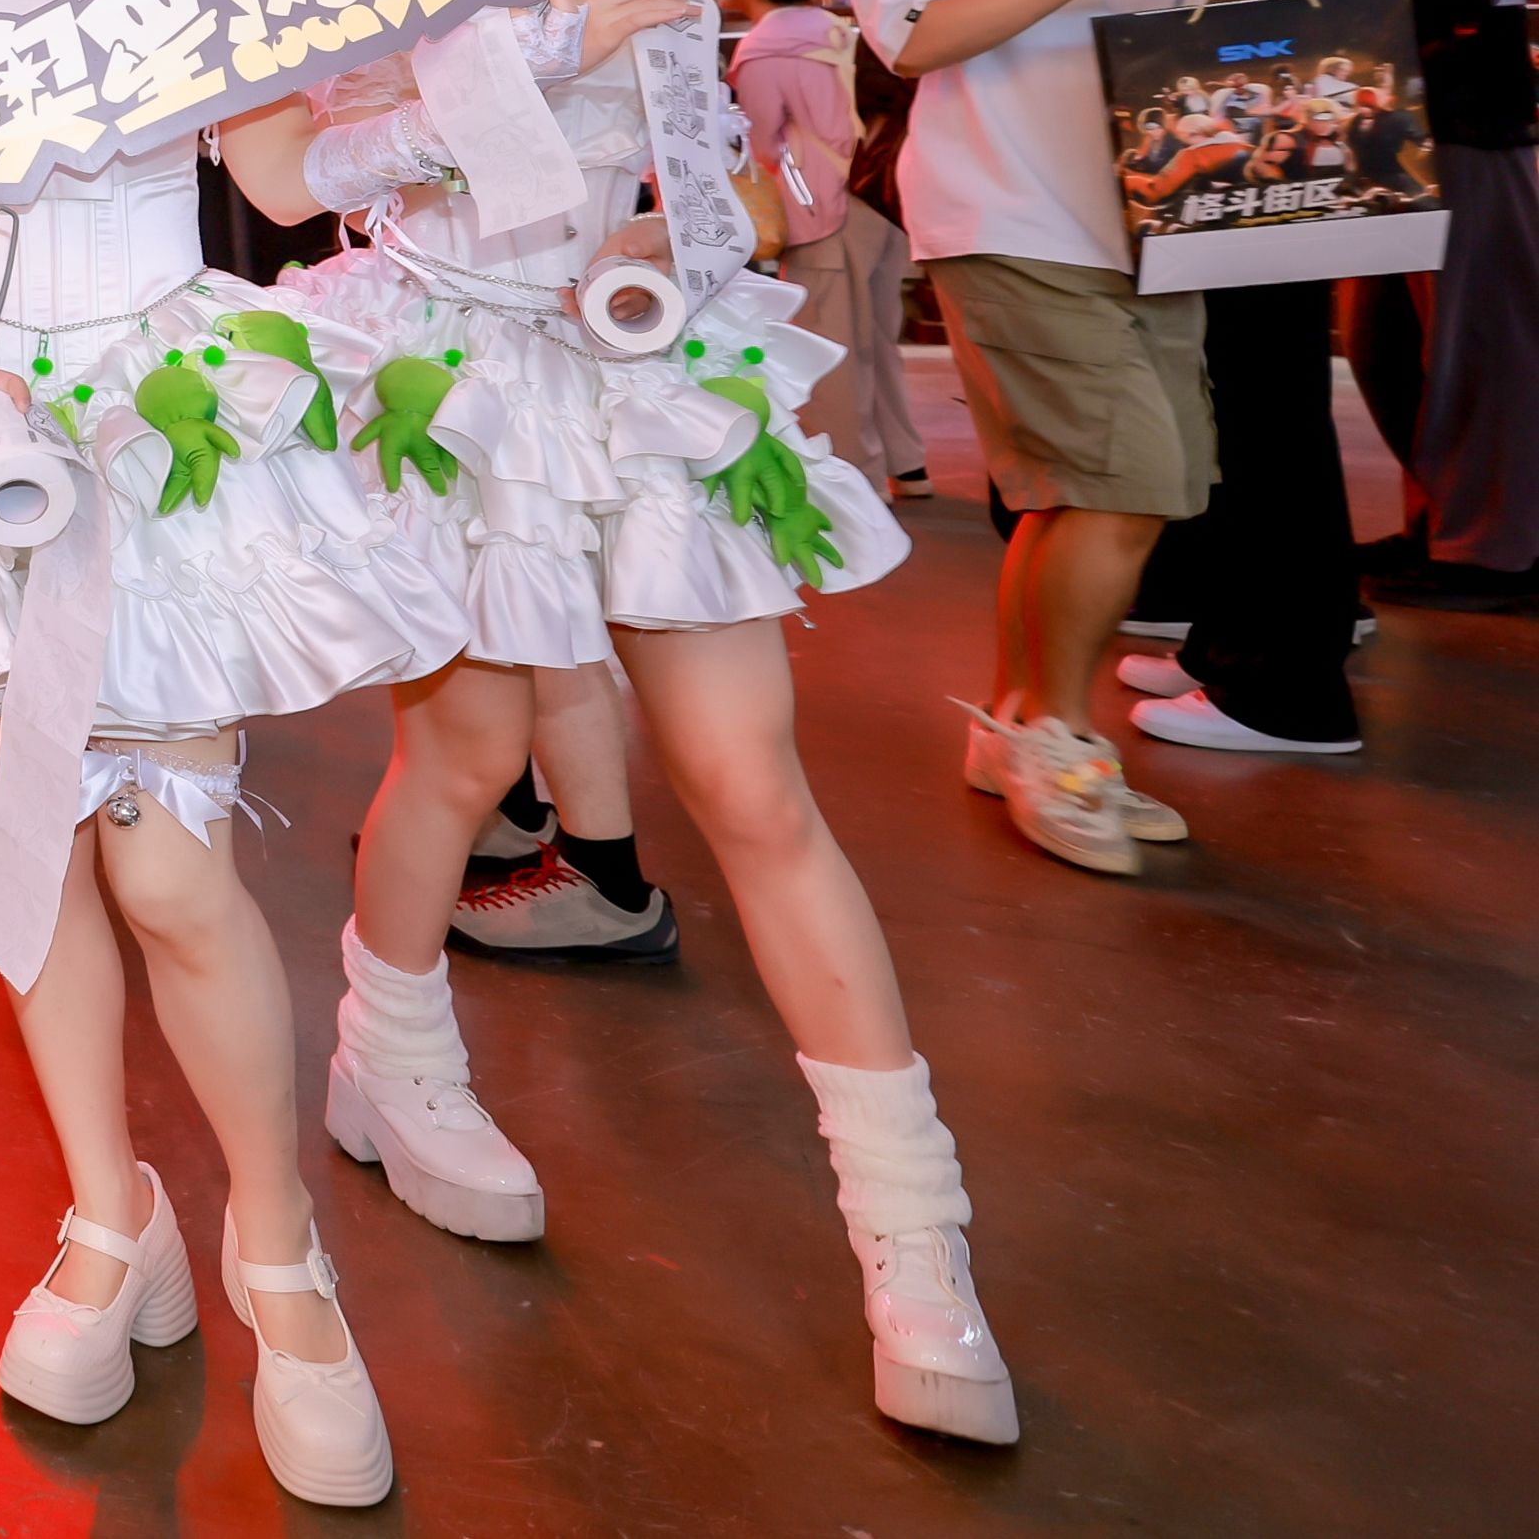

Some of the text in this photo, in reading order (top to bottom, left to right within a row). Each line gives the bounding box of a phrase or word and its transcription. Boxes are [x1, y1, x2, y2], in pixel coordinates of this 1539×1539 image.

[1216, 39, 1296, 62] SNK
[1180, 176, 1344, 224] 格斗街区
